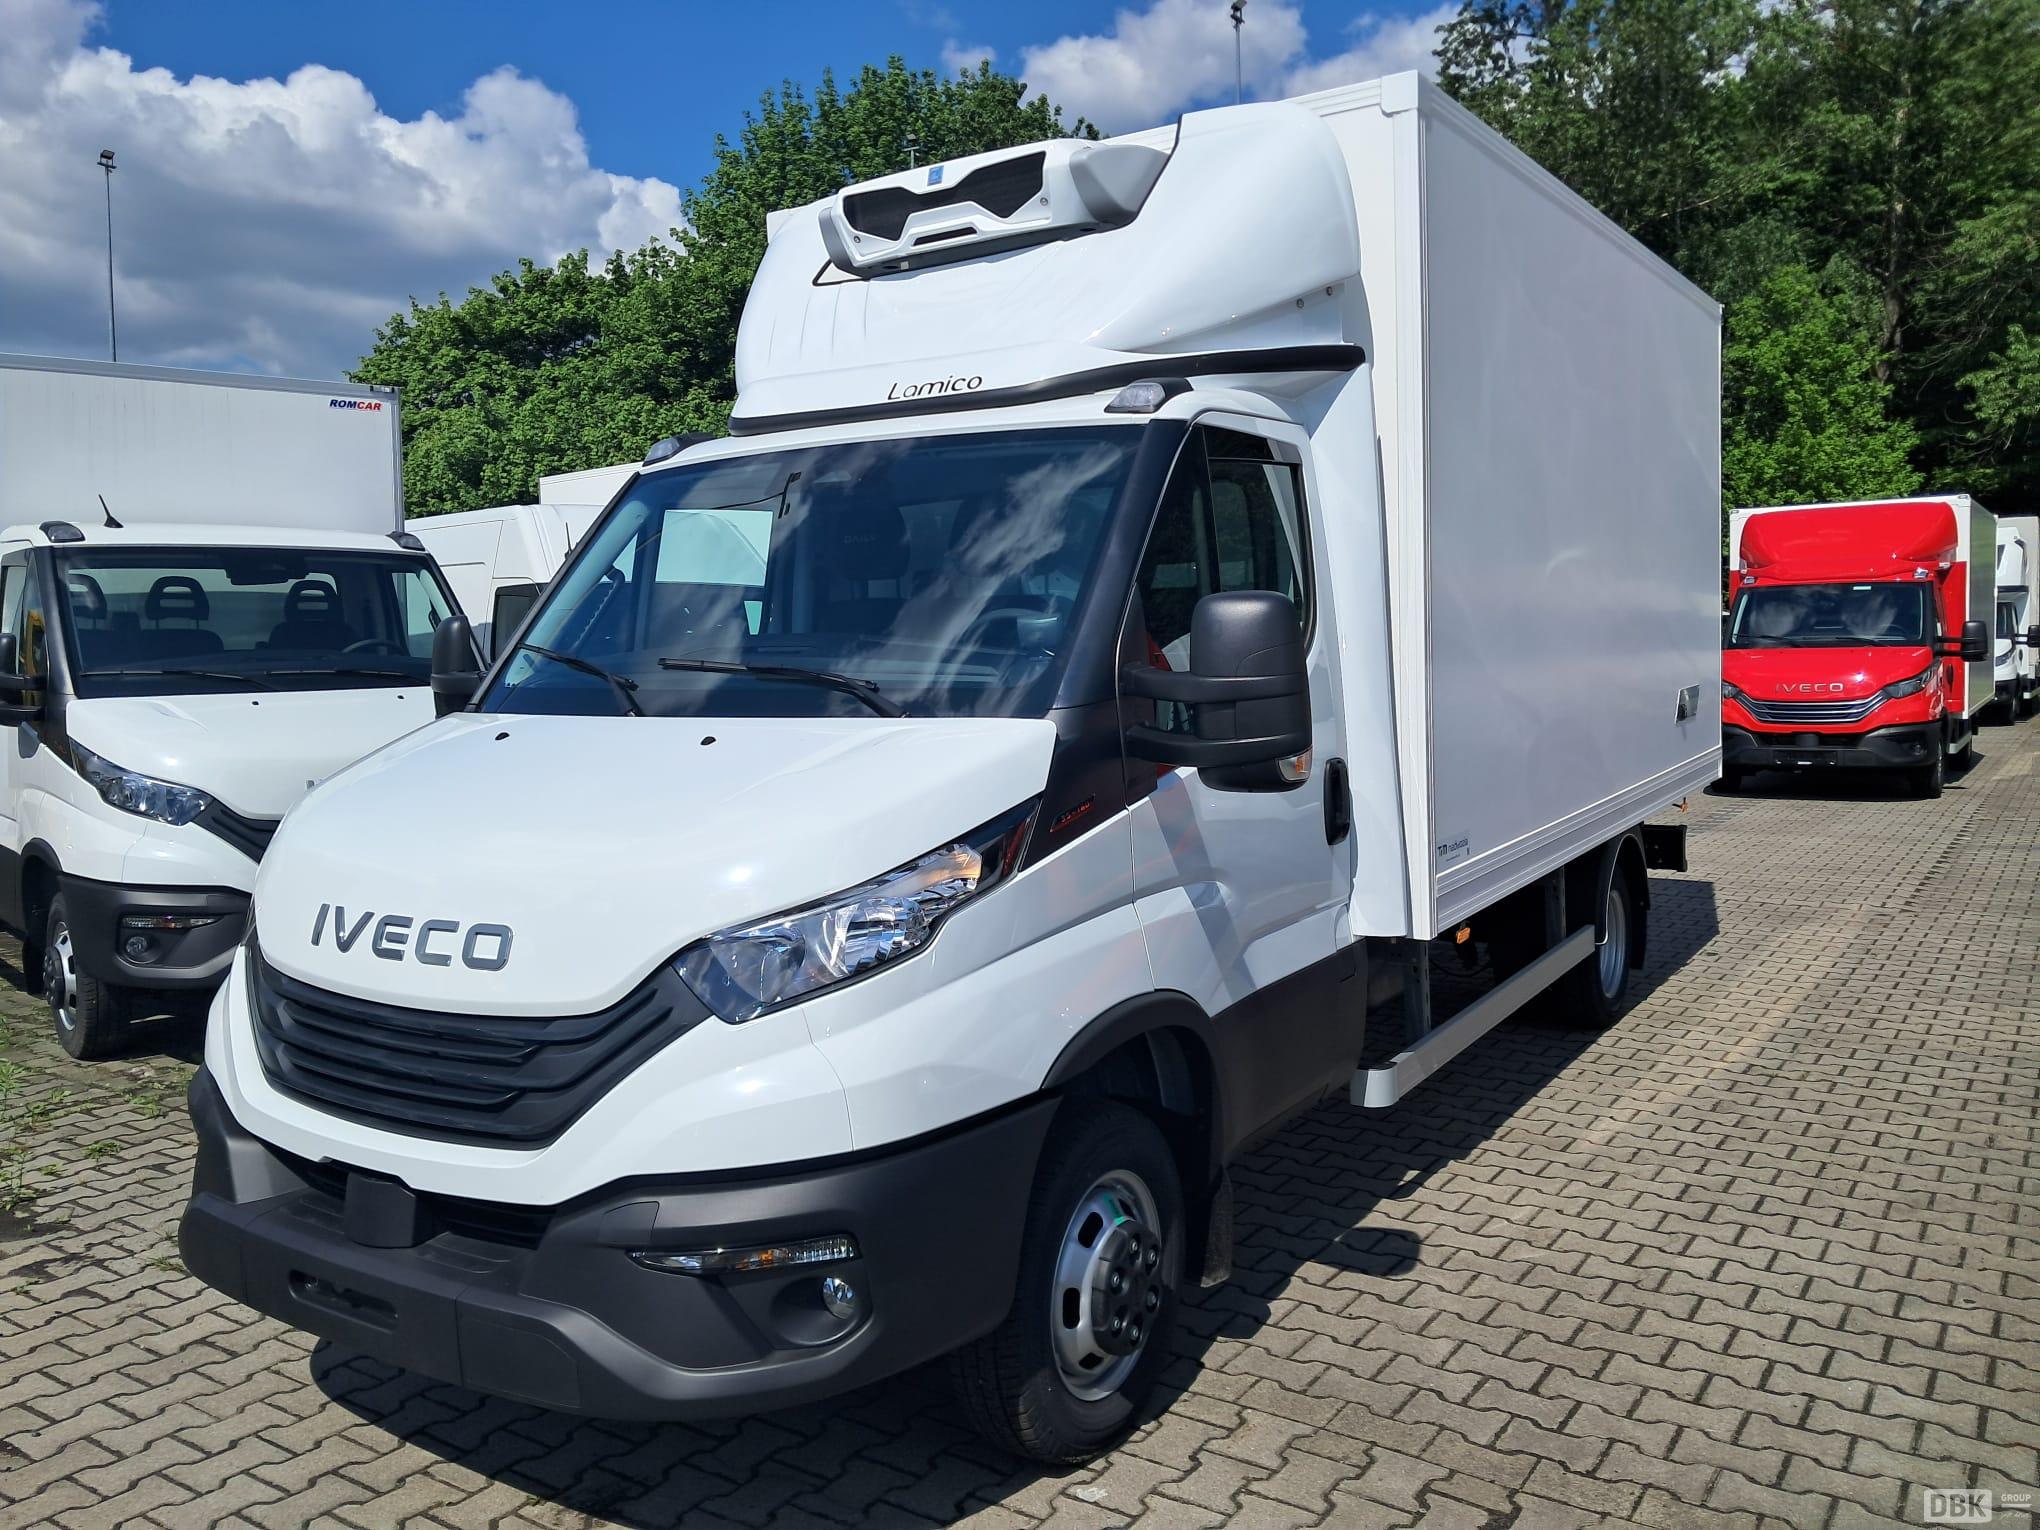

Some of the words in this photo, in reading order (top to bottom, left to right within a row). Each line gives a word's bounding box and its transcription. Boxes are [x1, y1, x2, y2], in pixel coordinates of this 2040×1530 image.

[887, 375, 983, 401] Lamico
[329, 399, 382, 411] ROMCAR
[1776, 683, 1844, 694] IVECO
[311, 903, 514, 972] IVECO
